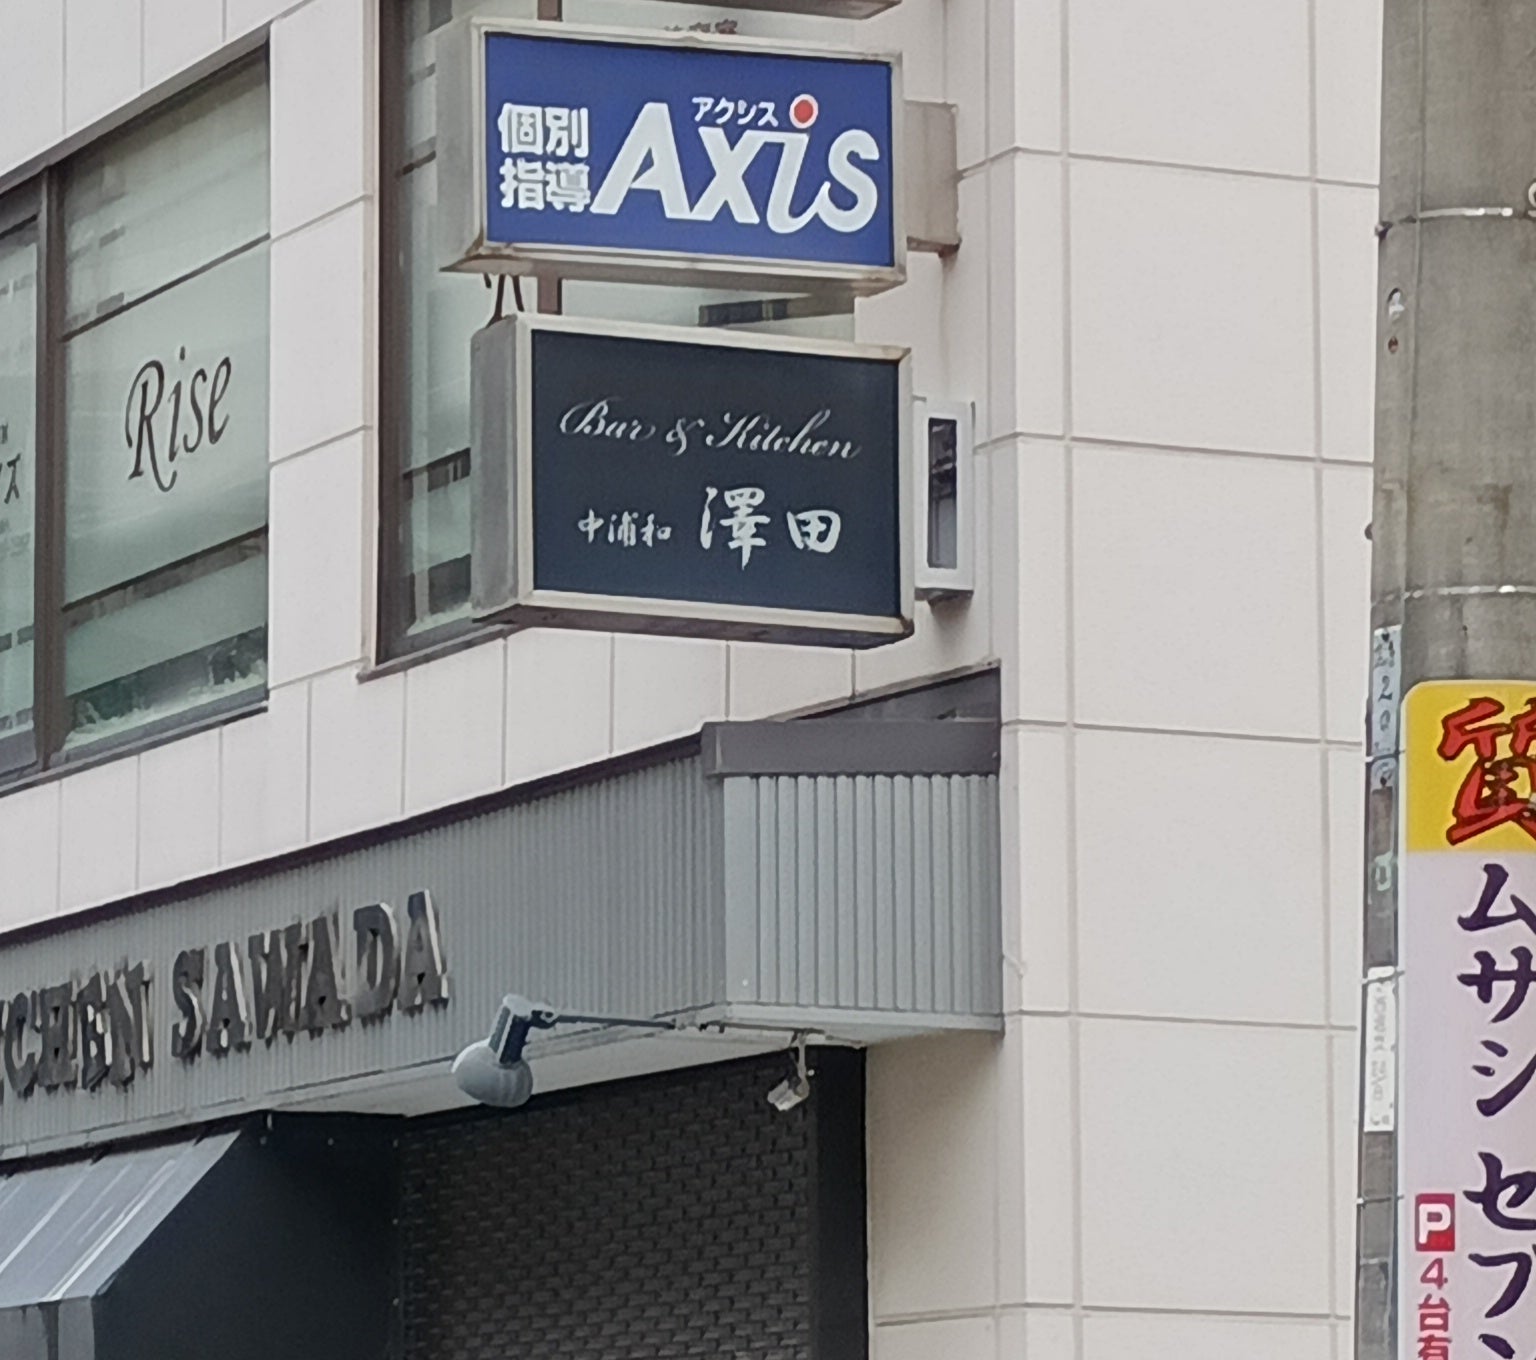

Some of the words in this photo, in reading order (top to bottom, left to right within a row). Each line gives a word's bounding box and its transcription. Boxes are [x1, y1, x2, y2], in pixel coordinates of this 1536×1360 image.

[498, 102, 590, 158] 個別
[691, 96, 779, 128] アクシス
[500, 161, 592, 214] 指導
[125, 346, 232, 493] Rise
[560, 396, 656, 441] Bar
[665, 418, 706, 457] &
[706, 409, 862, 459] Kitchen
[700, 486, 841, 570] 澤田
[171, 890, 451, 1061] SAWADA
